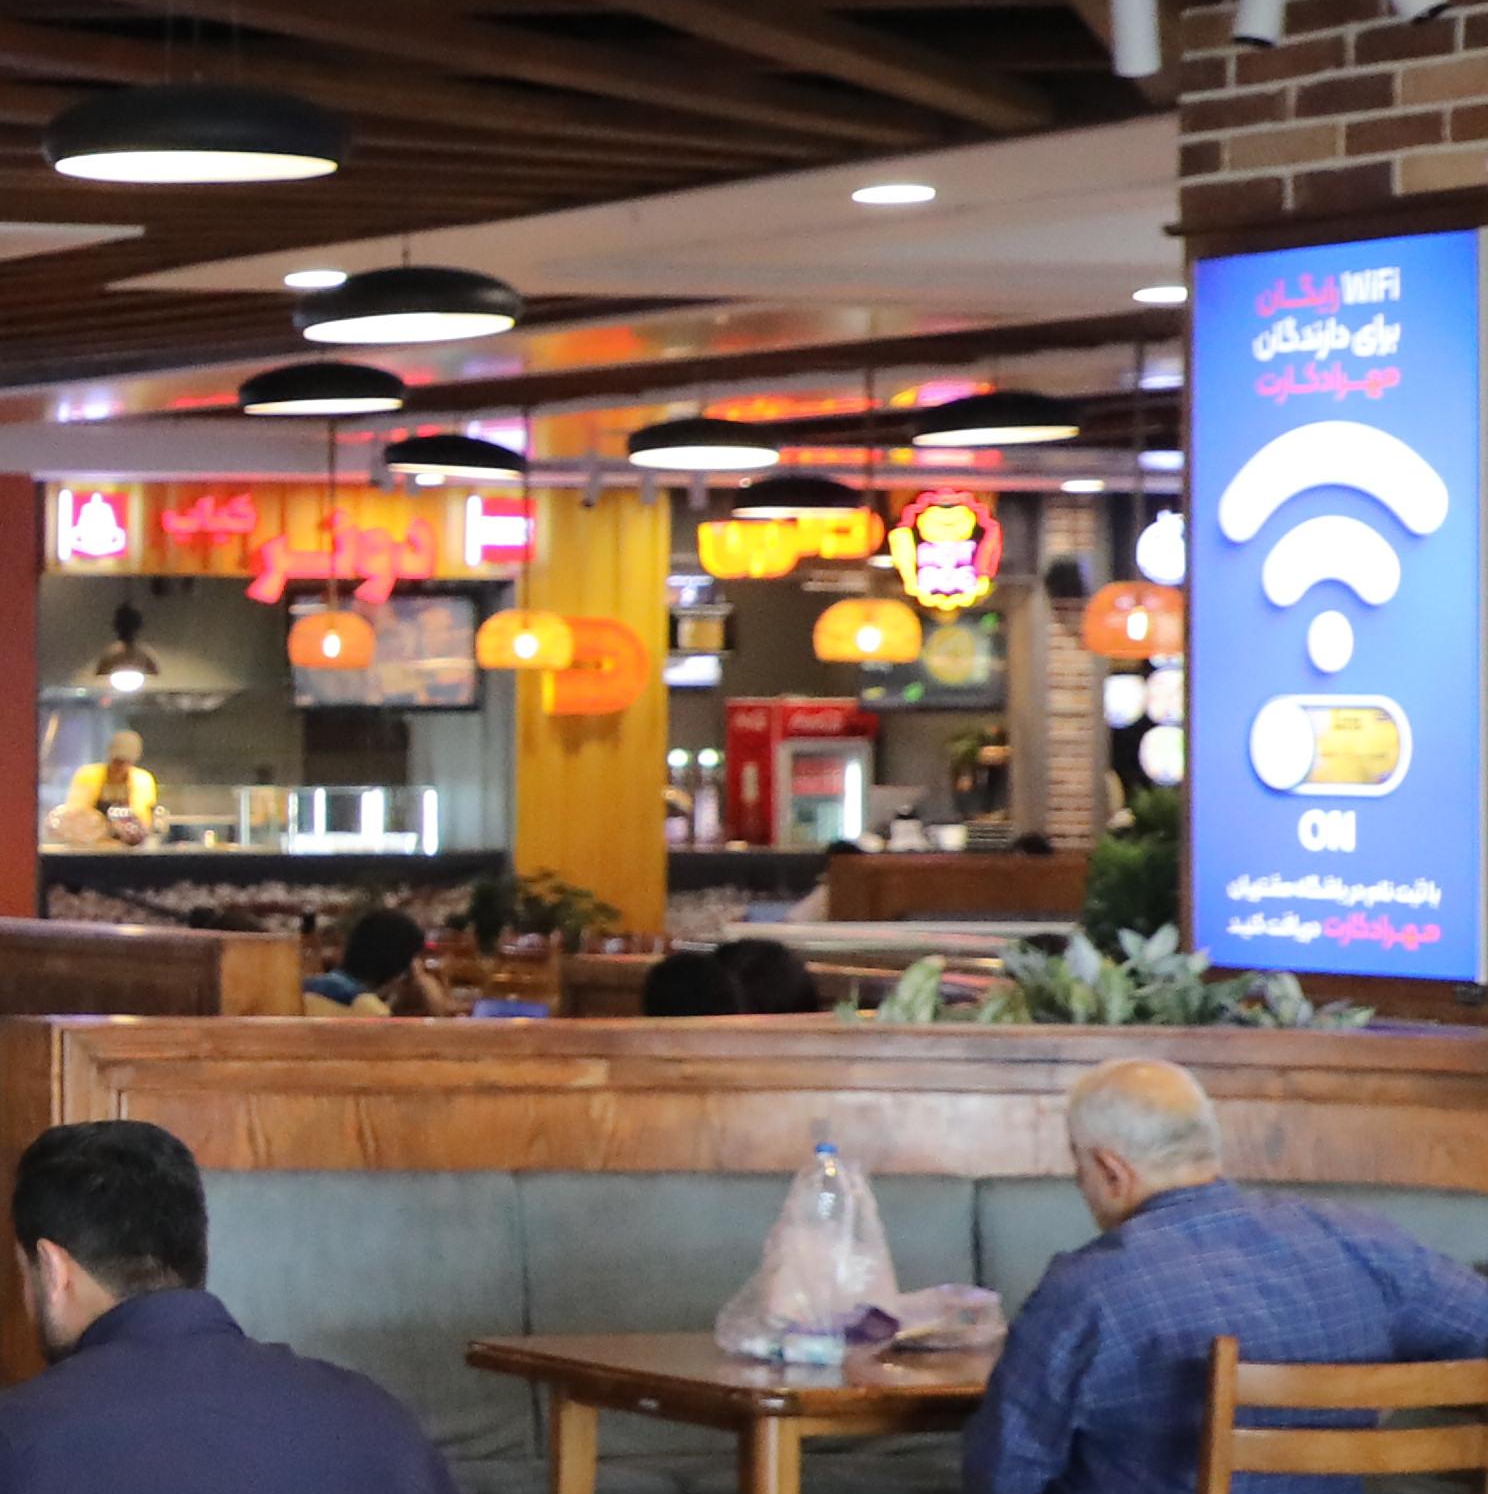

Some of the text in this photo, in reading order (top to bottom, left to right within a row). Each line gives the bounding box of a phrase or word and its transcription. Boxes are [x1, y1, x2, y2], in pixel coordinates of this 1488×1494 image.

[1255, 266, 1402, 318] WiFi رایگان
[1351, 312, 1402, 357] برای
[1298, 808, 1357, 852] ON
